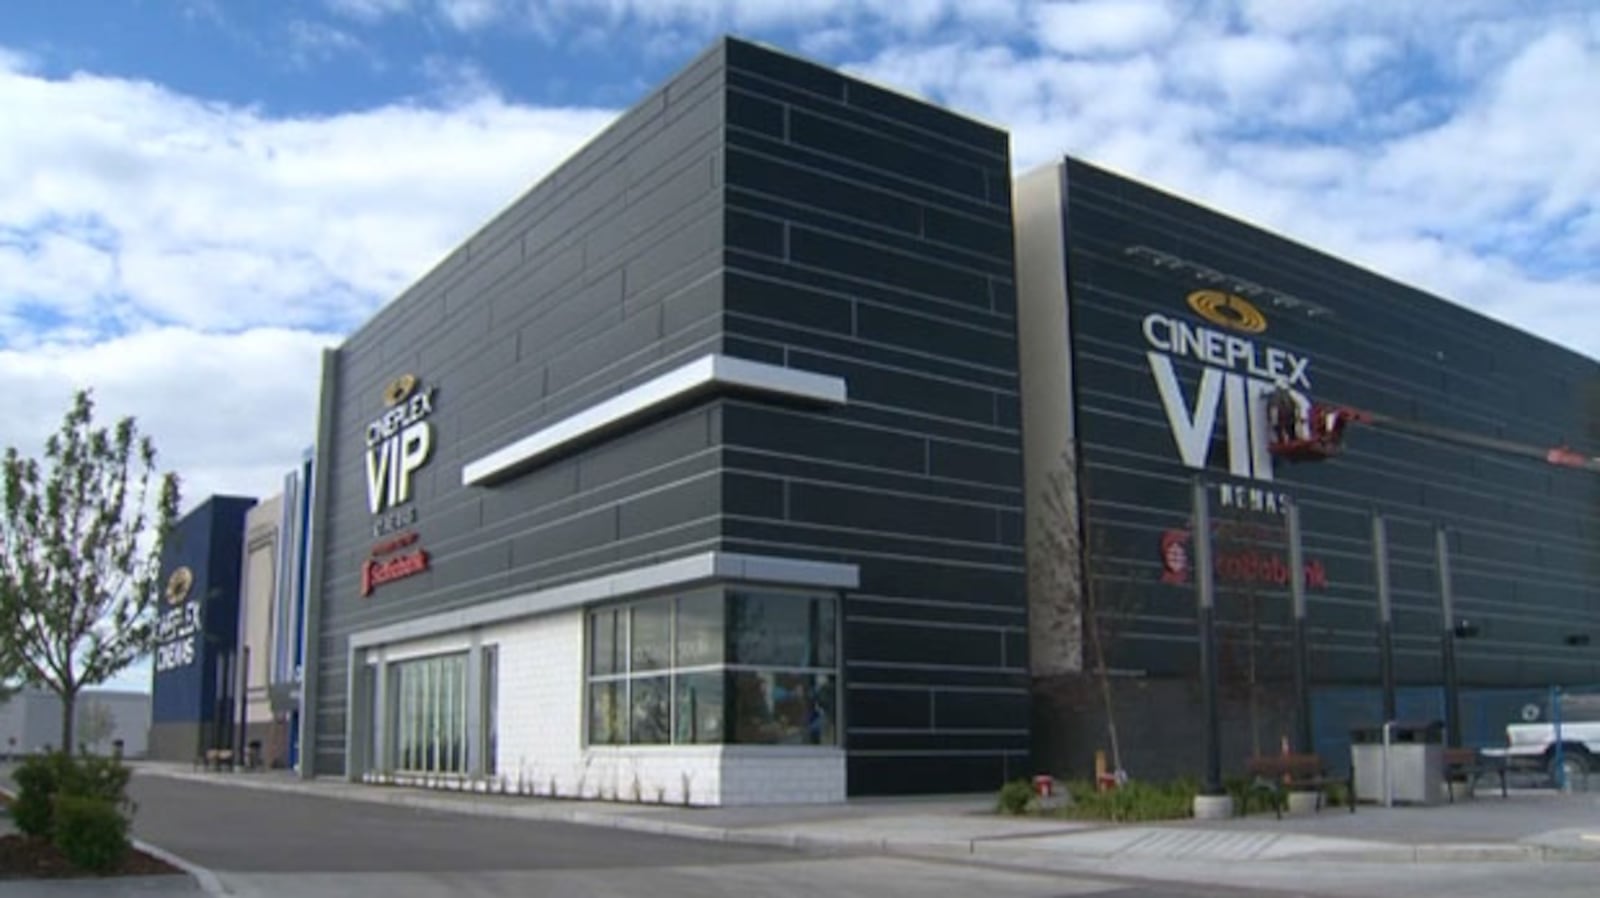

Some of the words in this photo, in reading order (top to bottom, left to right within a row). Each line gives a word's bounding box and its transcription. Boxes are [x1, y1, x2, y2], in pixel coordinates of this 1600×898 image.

[1142, 313, 1311, 389] CINEPLEX
[1147, 351, 1313, 482] VIP
[365, 420, 430, 515] VIP
